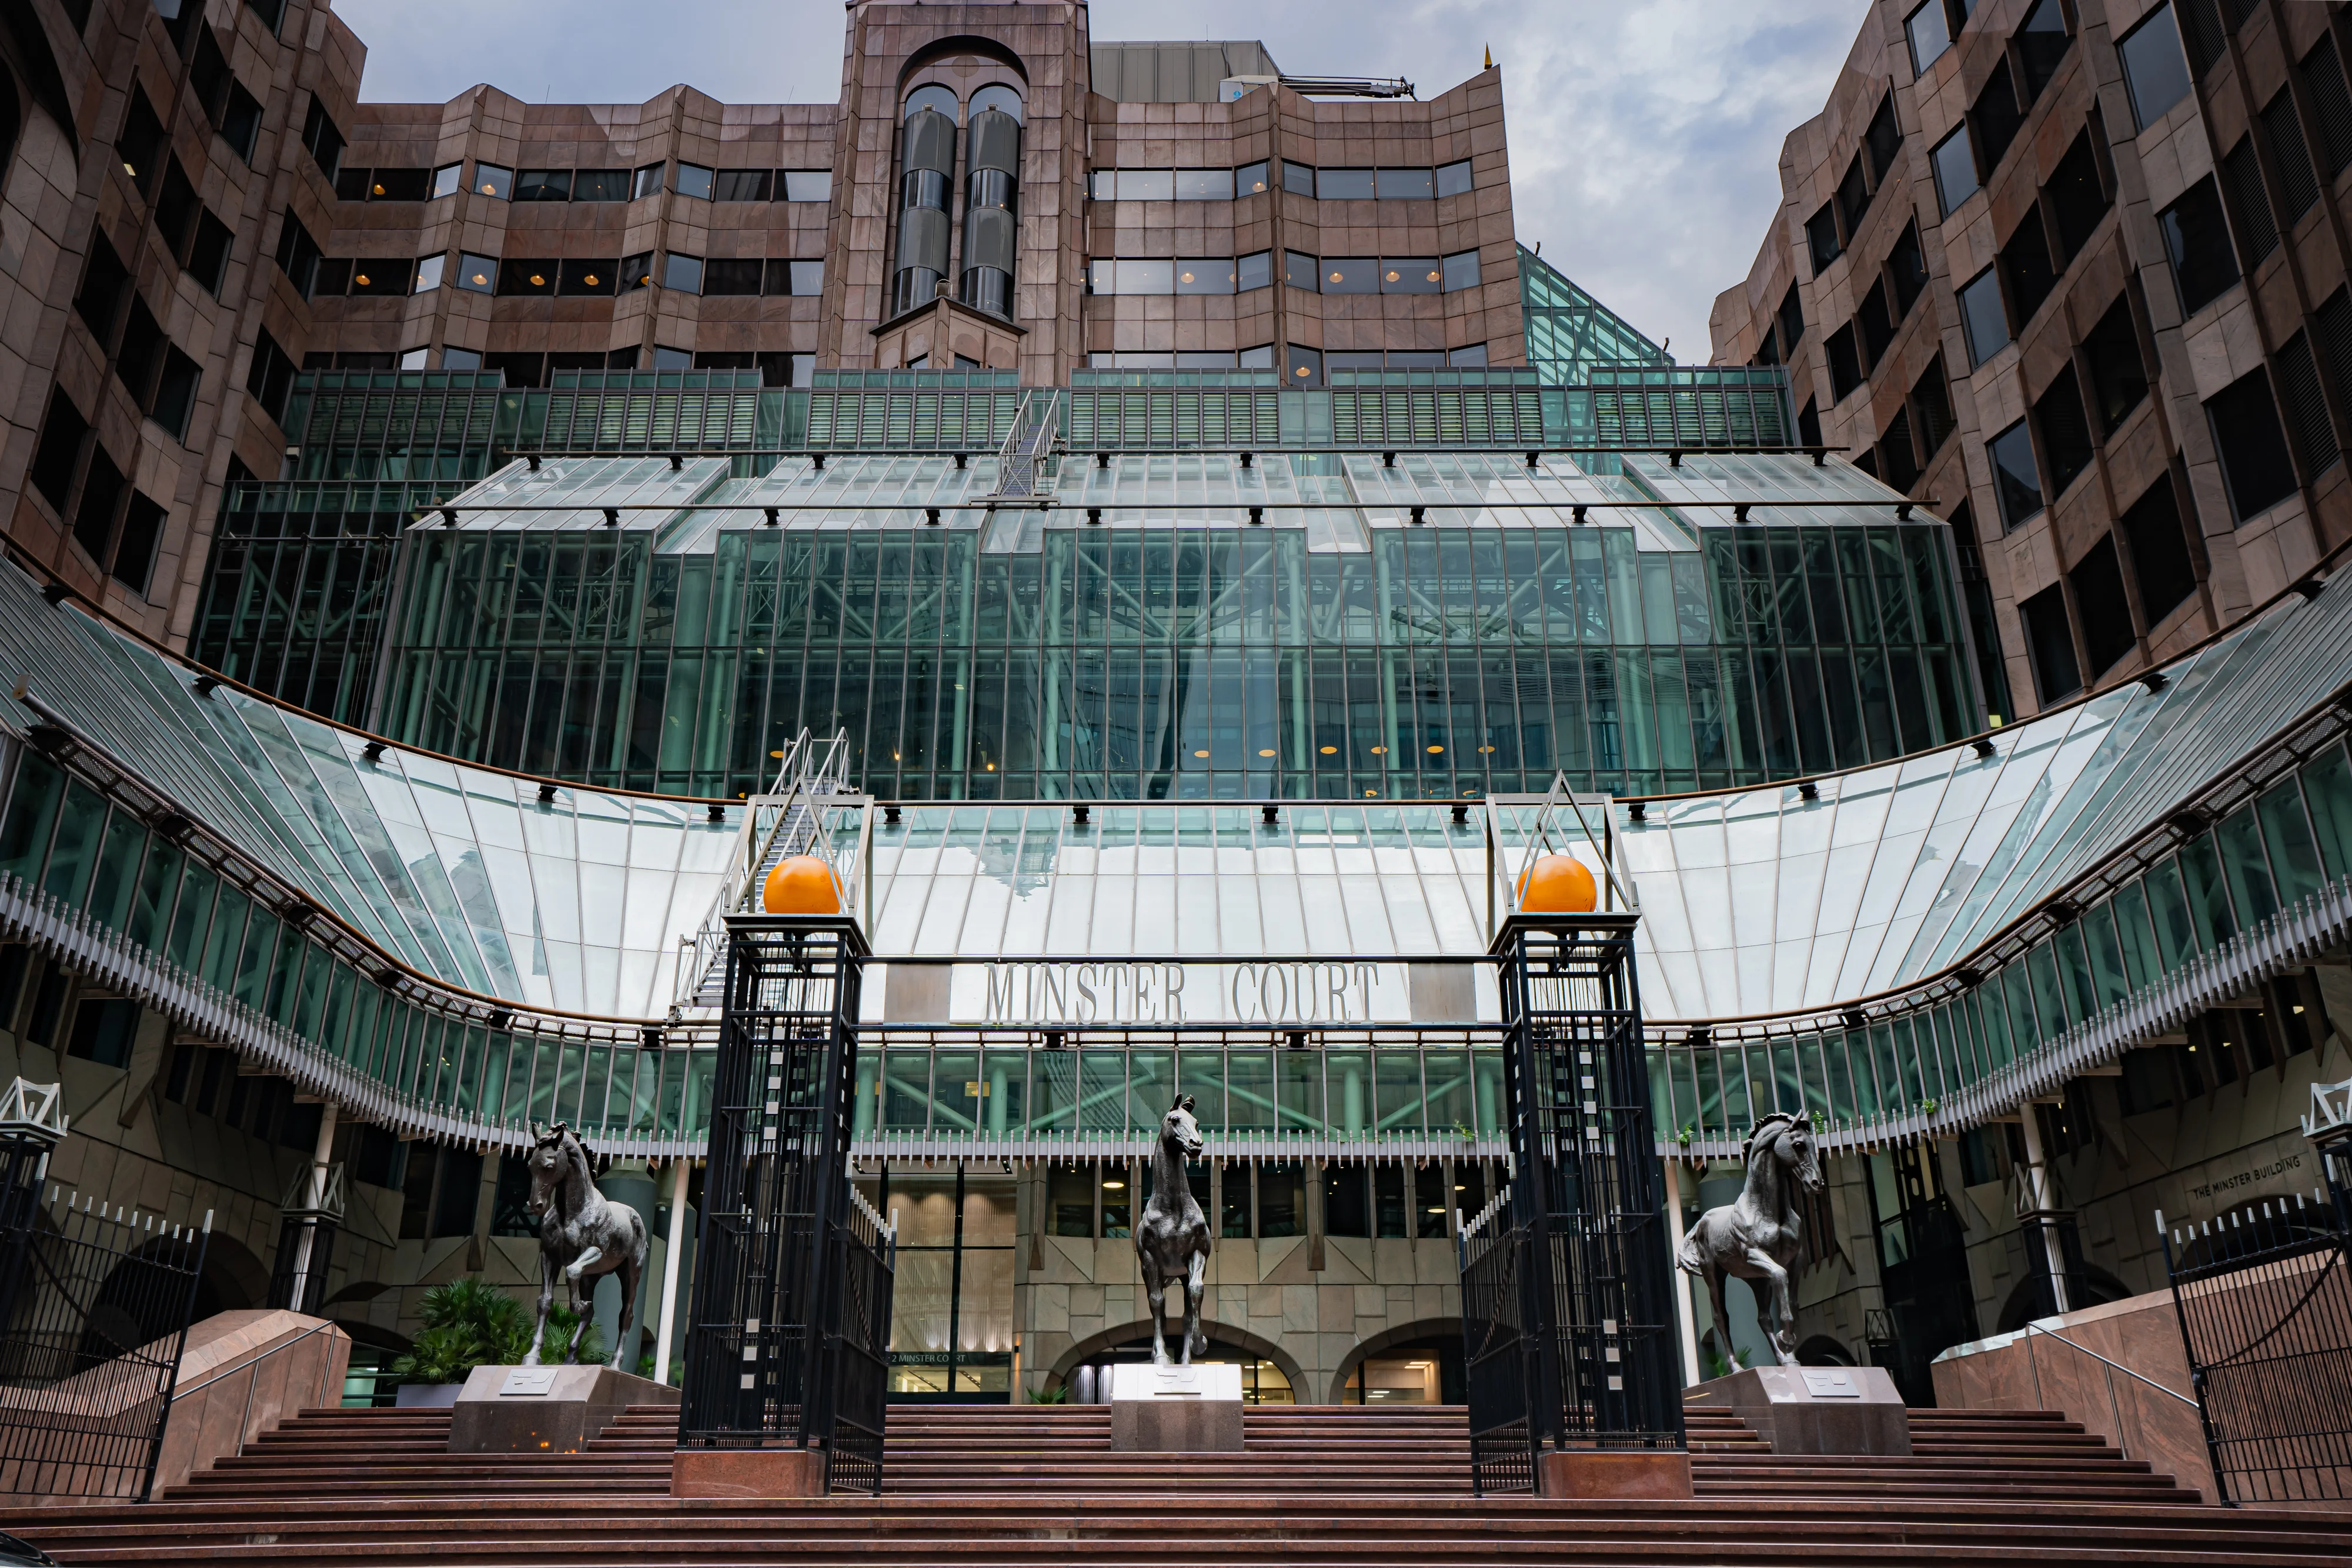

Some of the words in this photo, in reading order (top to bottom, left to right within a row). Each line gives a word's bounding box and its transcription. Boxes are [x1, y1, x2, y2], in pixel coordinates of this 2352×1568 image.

[981, 962, 1187, 1025] MINSTER
[1232, 962, 1378, 1024] COURT
[2193, 1184, 2211, 1200] THE
[2212, 1172, 2251, 1193] MINSTER
[2253, 1156, 2300, 1181] BUILDING
